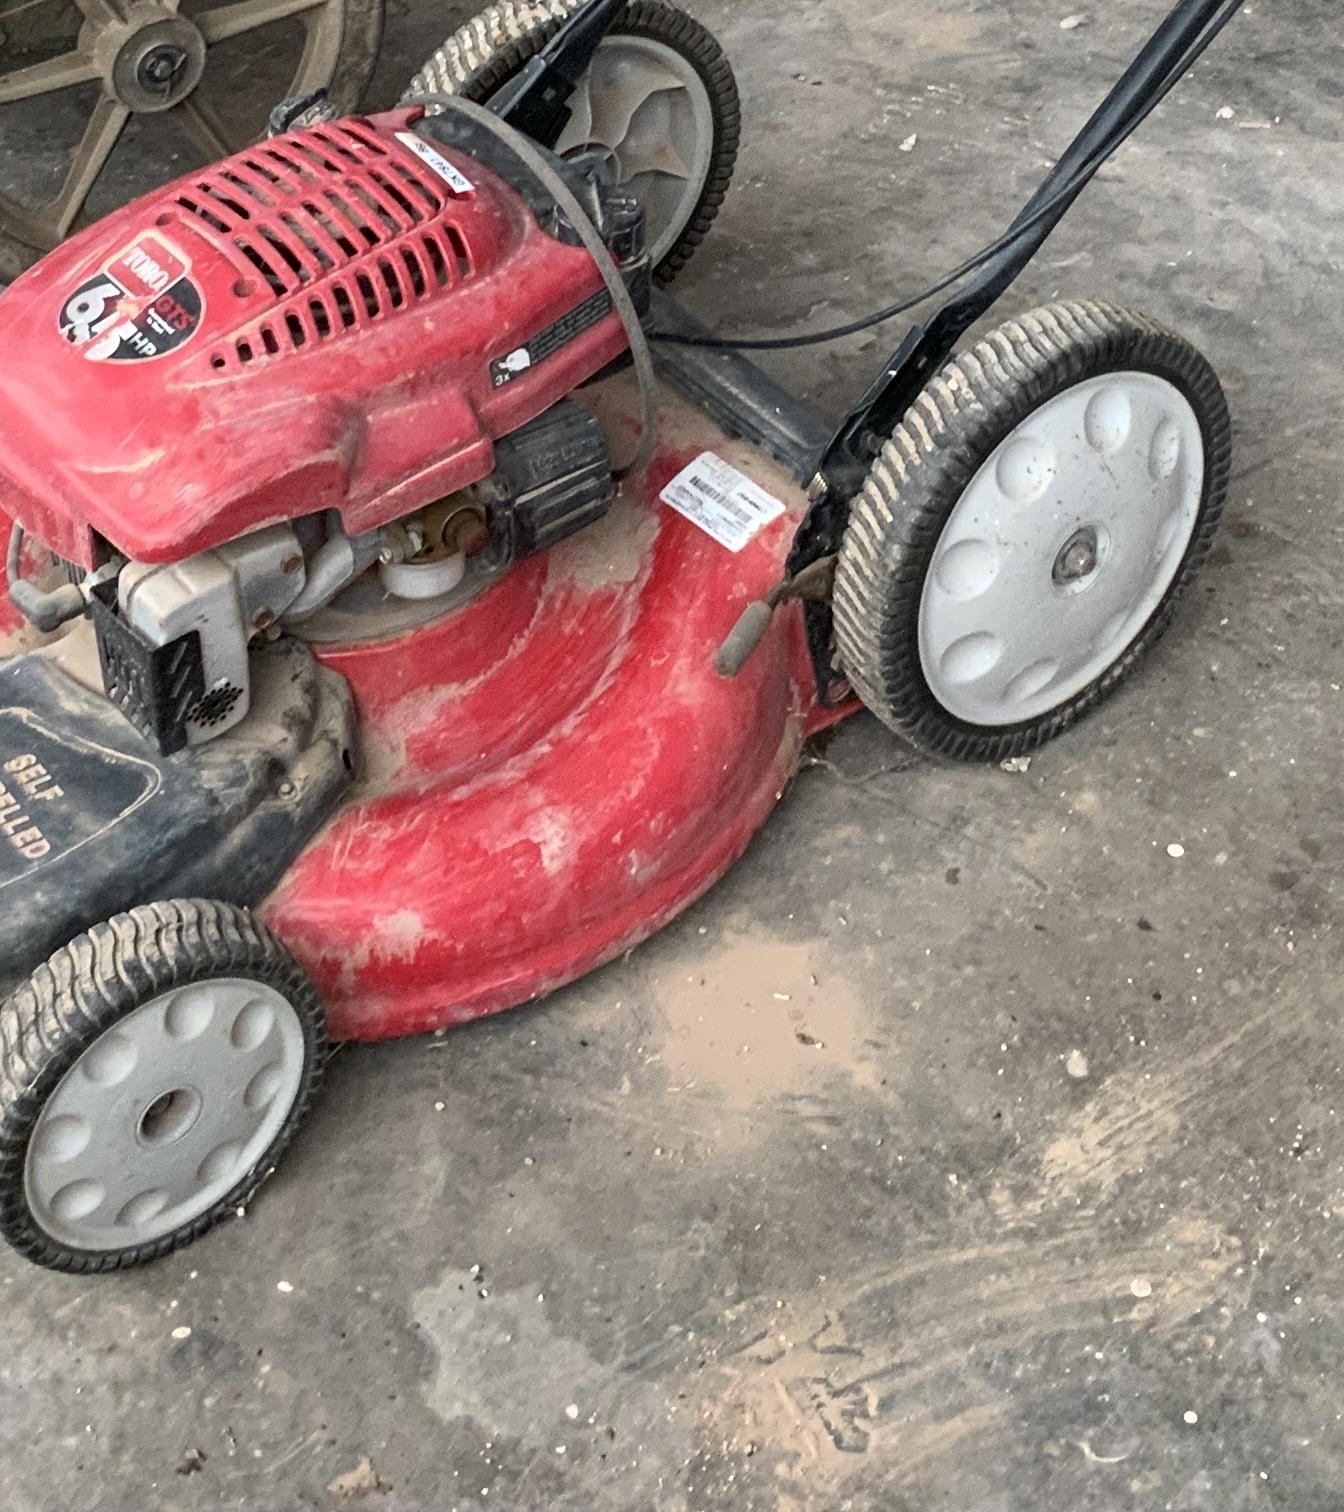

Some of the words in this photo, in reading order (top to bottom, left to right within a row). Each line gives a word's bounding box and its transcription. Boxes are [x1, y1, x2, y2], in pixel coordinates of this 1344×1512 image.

[122, 246, 168, 290] TORO
[156, 294, 194, 330] GTS
[128, 331, 157, 357] HP
[3, 753, 65, 801] SELF
